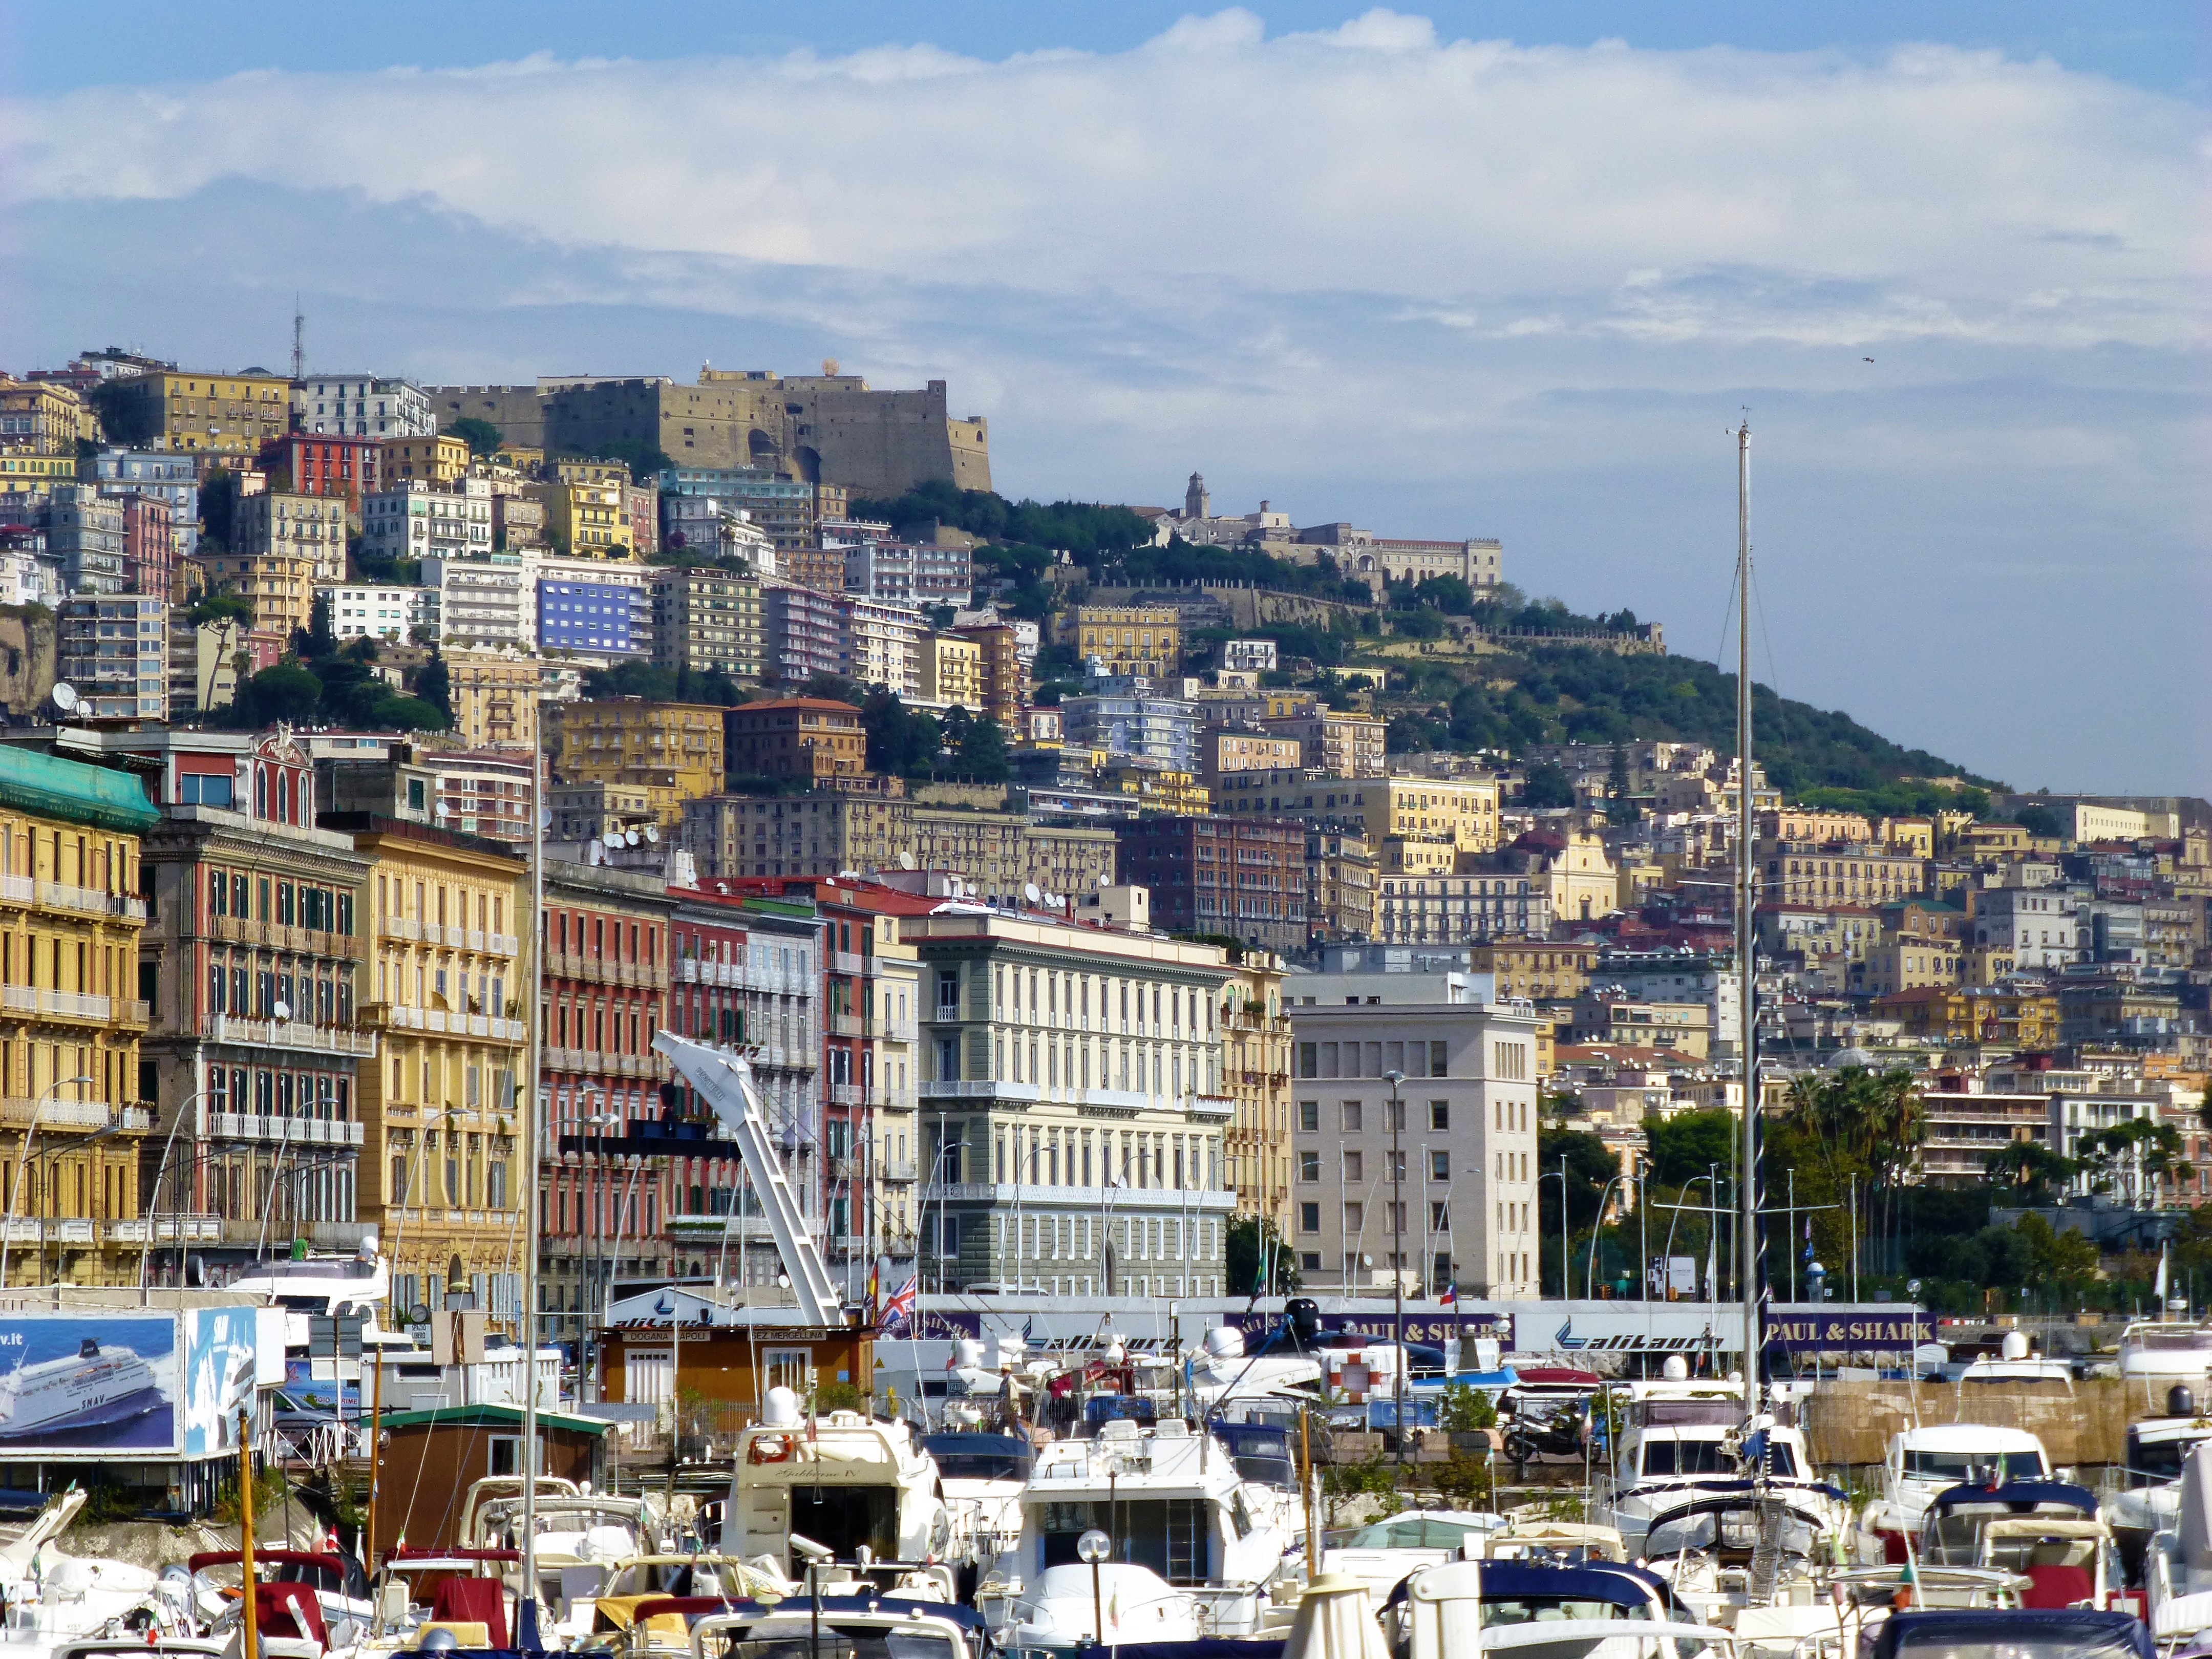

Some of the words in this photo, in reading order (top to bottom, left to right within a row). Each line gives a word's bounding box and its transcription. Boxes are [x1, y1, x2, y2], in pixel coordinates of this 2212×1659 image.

[1354, 1323, 1396, 1340] AUL
[1405, 1323, 1424, 1342] &
[1767, 1323, 1821, 1341] PAUL
[1825, 1323, 1844, 1341] &
[1849, 1323, 1933, 1341] SHARK
[81, 1394, 105, 1409] SNAV
